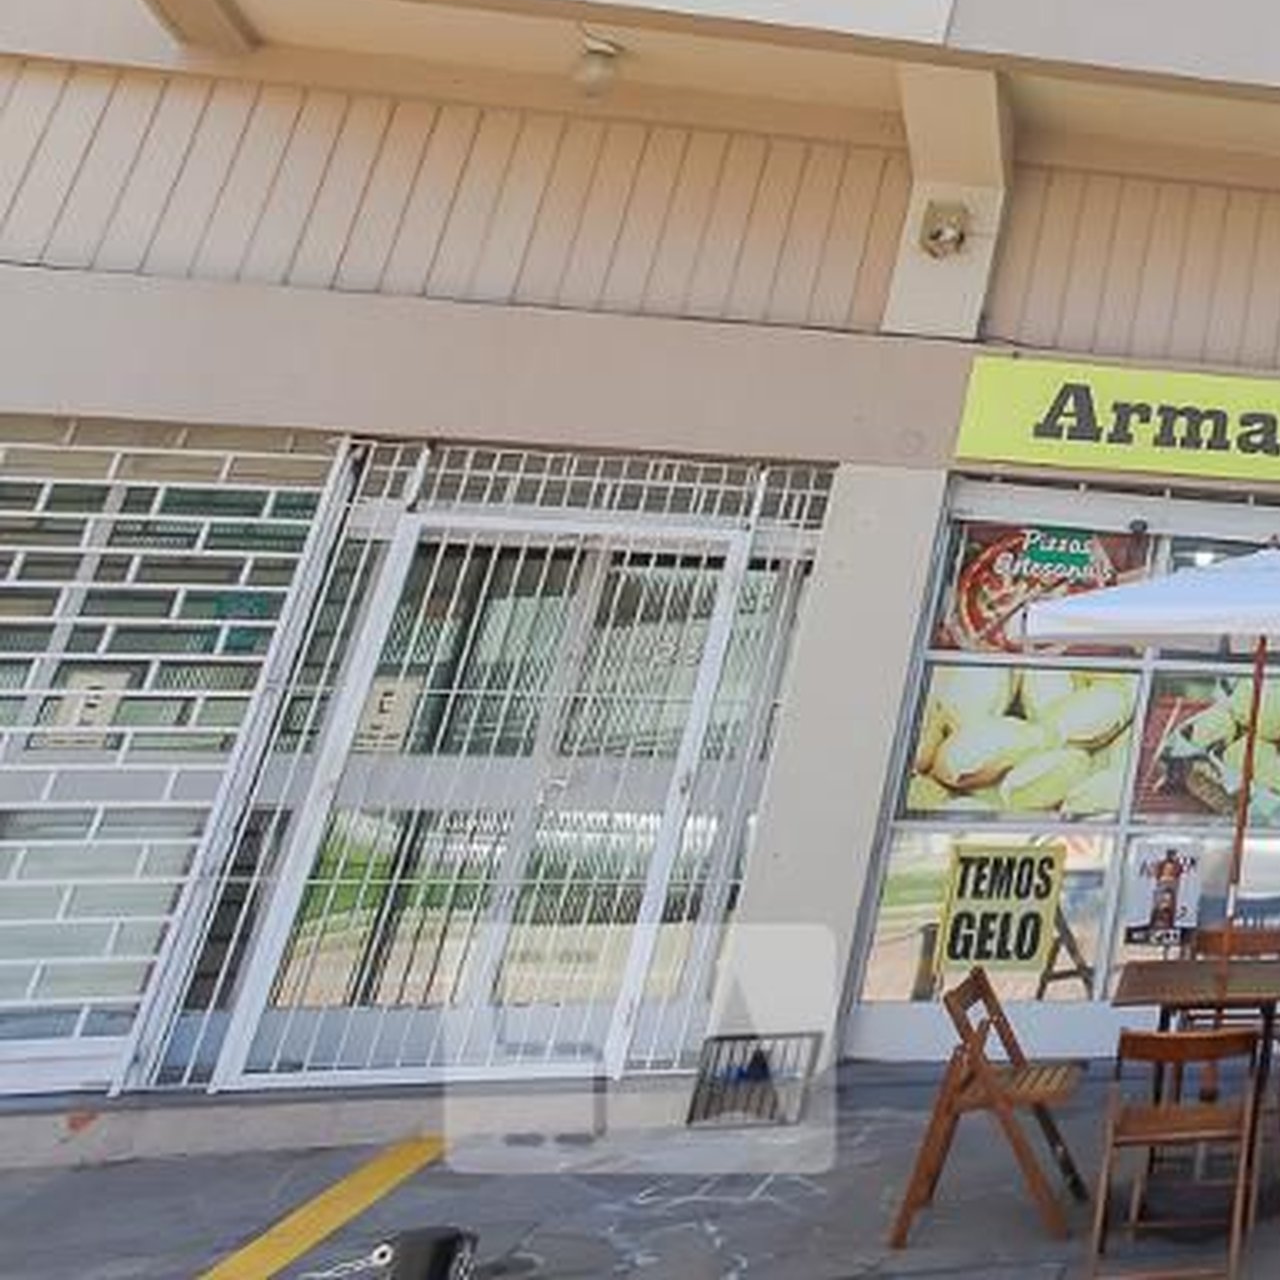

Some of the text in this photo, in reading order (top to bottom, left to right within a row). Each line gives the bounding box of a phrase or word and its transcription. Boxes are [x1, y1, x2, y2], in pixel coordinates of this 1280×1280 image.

[1022, 529, 1094, 554] Pizzas
[956, 855, 1056, 900] TEMOS
[947, 910, 1043, 961] GELO
